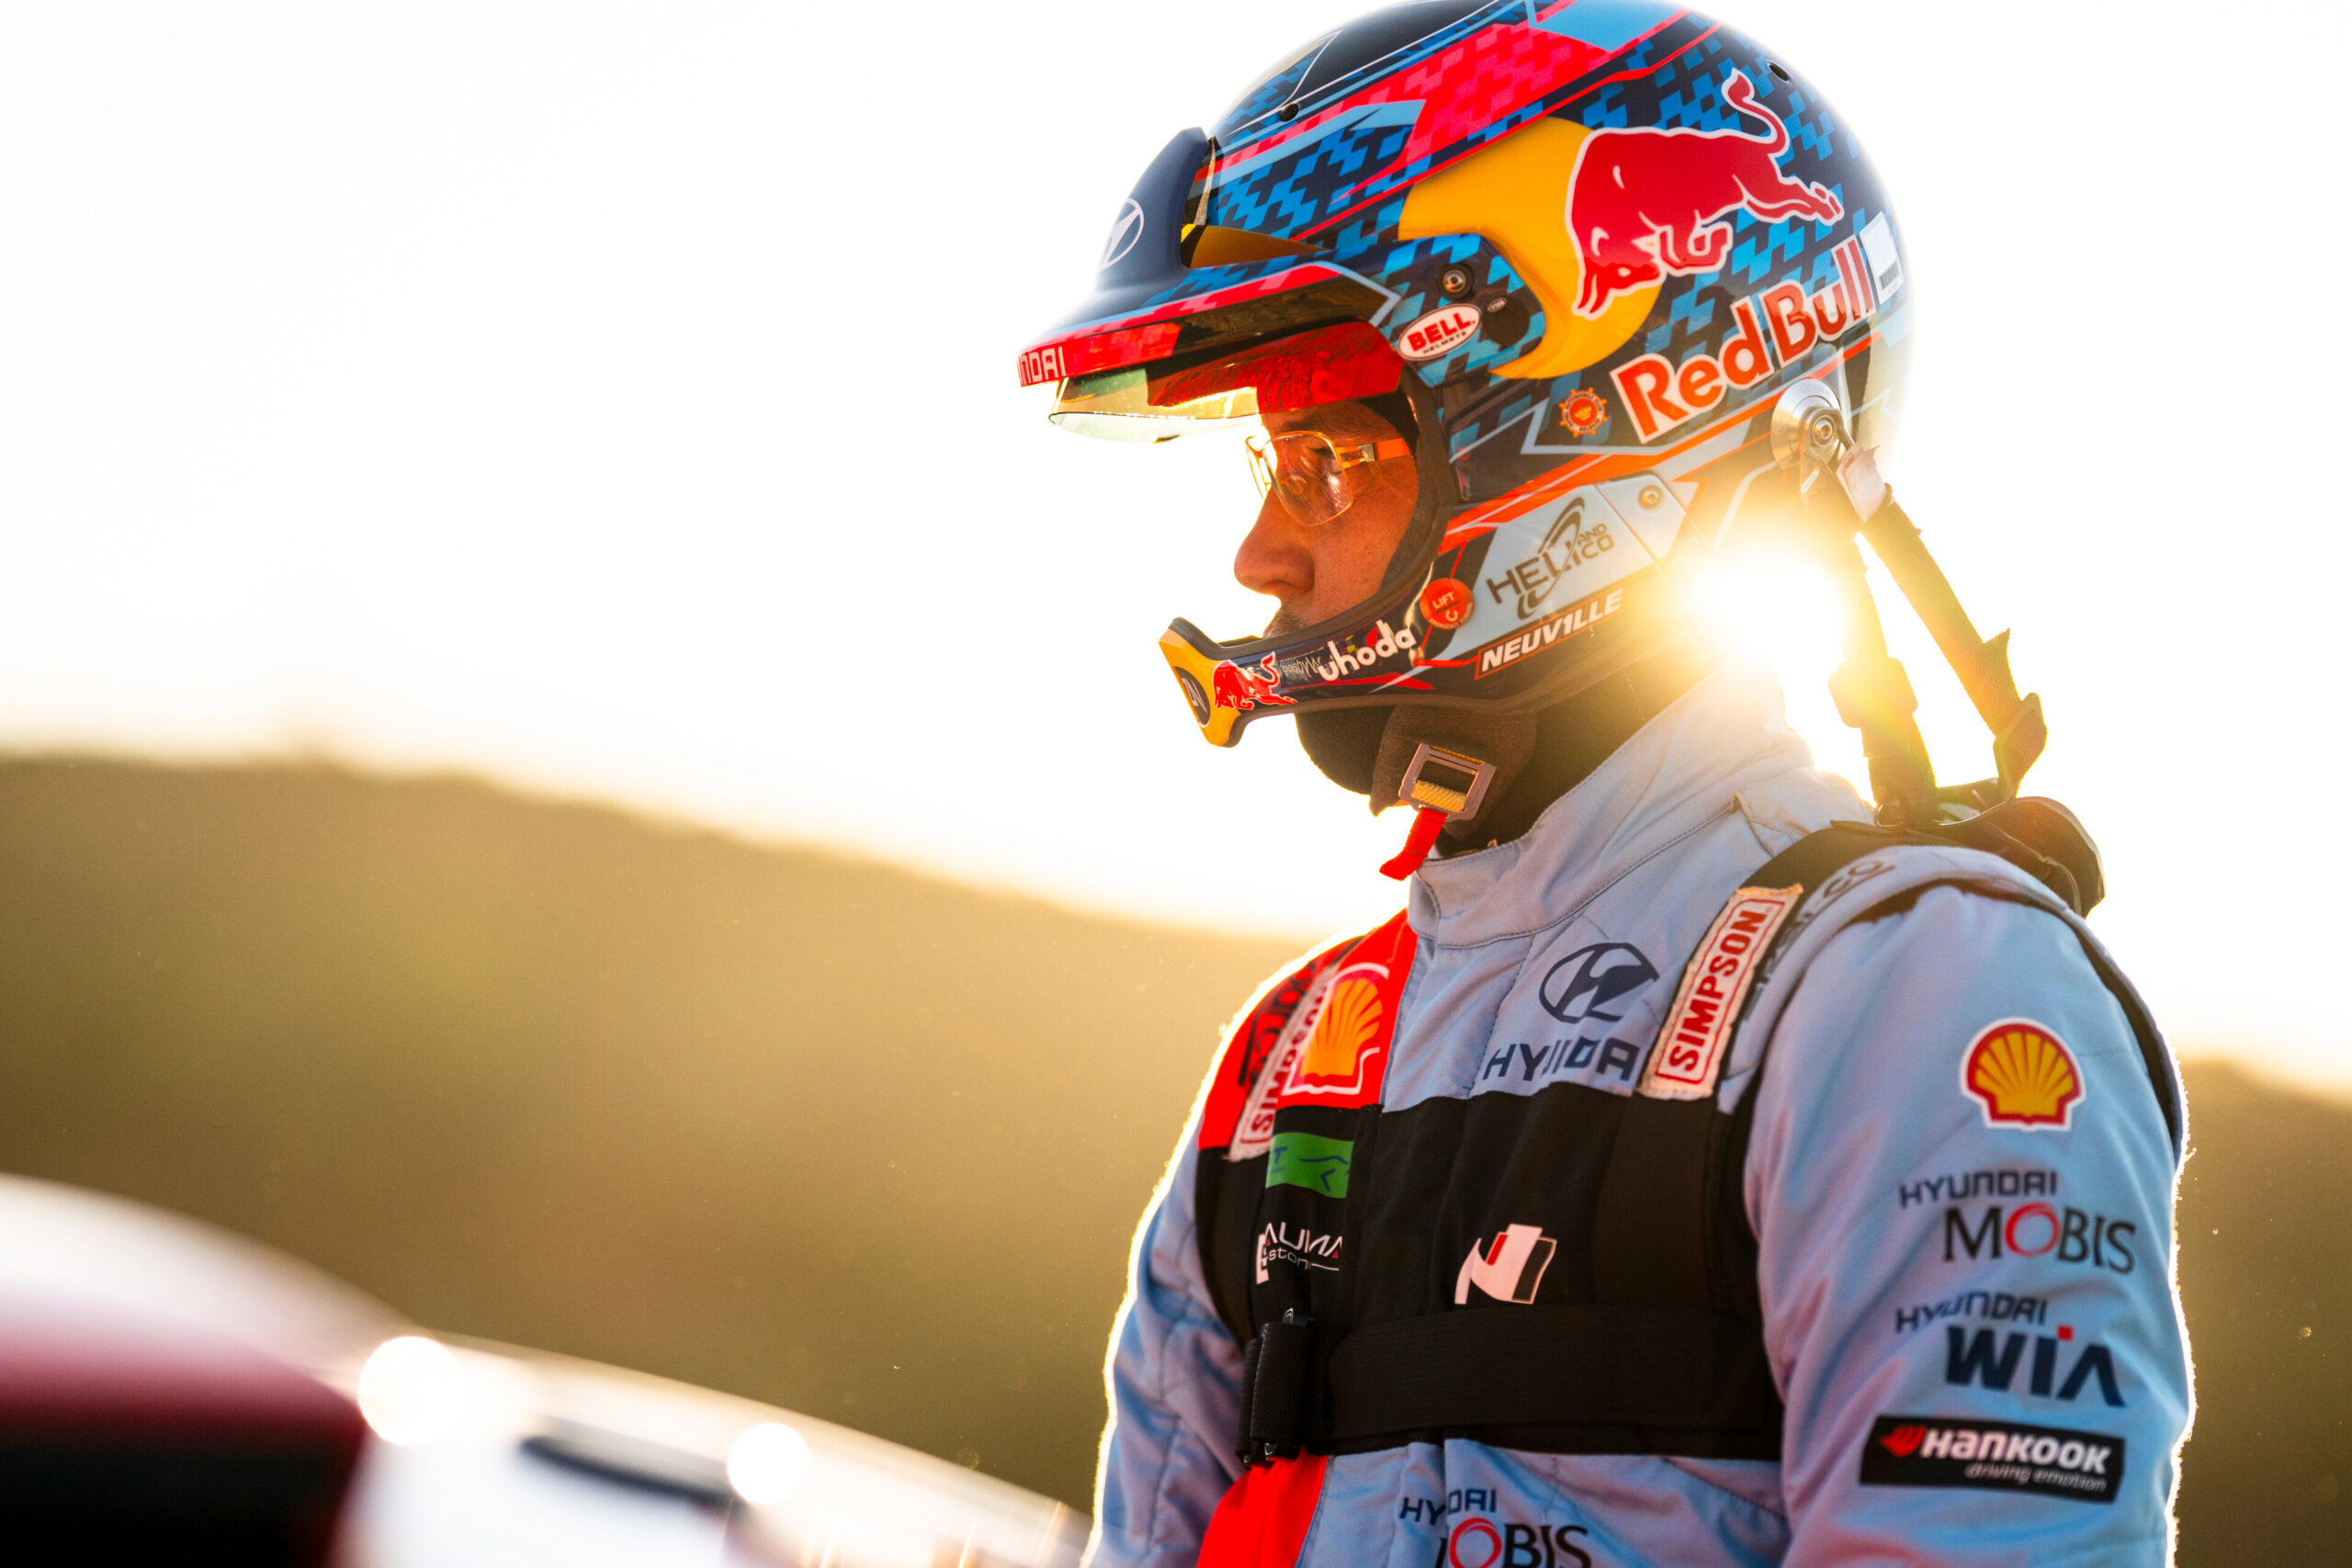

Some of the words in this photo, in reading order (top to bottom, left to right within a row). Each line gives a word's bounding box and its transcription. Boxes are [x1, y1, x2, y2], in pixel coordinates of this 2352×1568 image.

[1407, 312, 1472, 352] BELL
[1422, 332, 1467, 355] HELMETS
[1614, 300, 1772, 440] Red
[1761, 236, 1876, 365] Bull
[1017, 346, 1066, 386] NDAI
[1431, 591, 1454, 609] LIFT
[1317, 619, 1417, 682] uhoda
[1668, 909, 1768, 1073] SIMPSON
[1898, 1170, 2058, 1209] HYUNDAI
[1942, 1201, 2137, 1276] MOBIS
[1895, 1290, 2050, 1333] HYUNDAI
[1945, 1324, 2127, 1409] WIA
[1399, 1488, 1498, 1526] HYDAI
